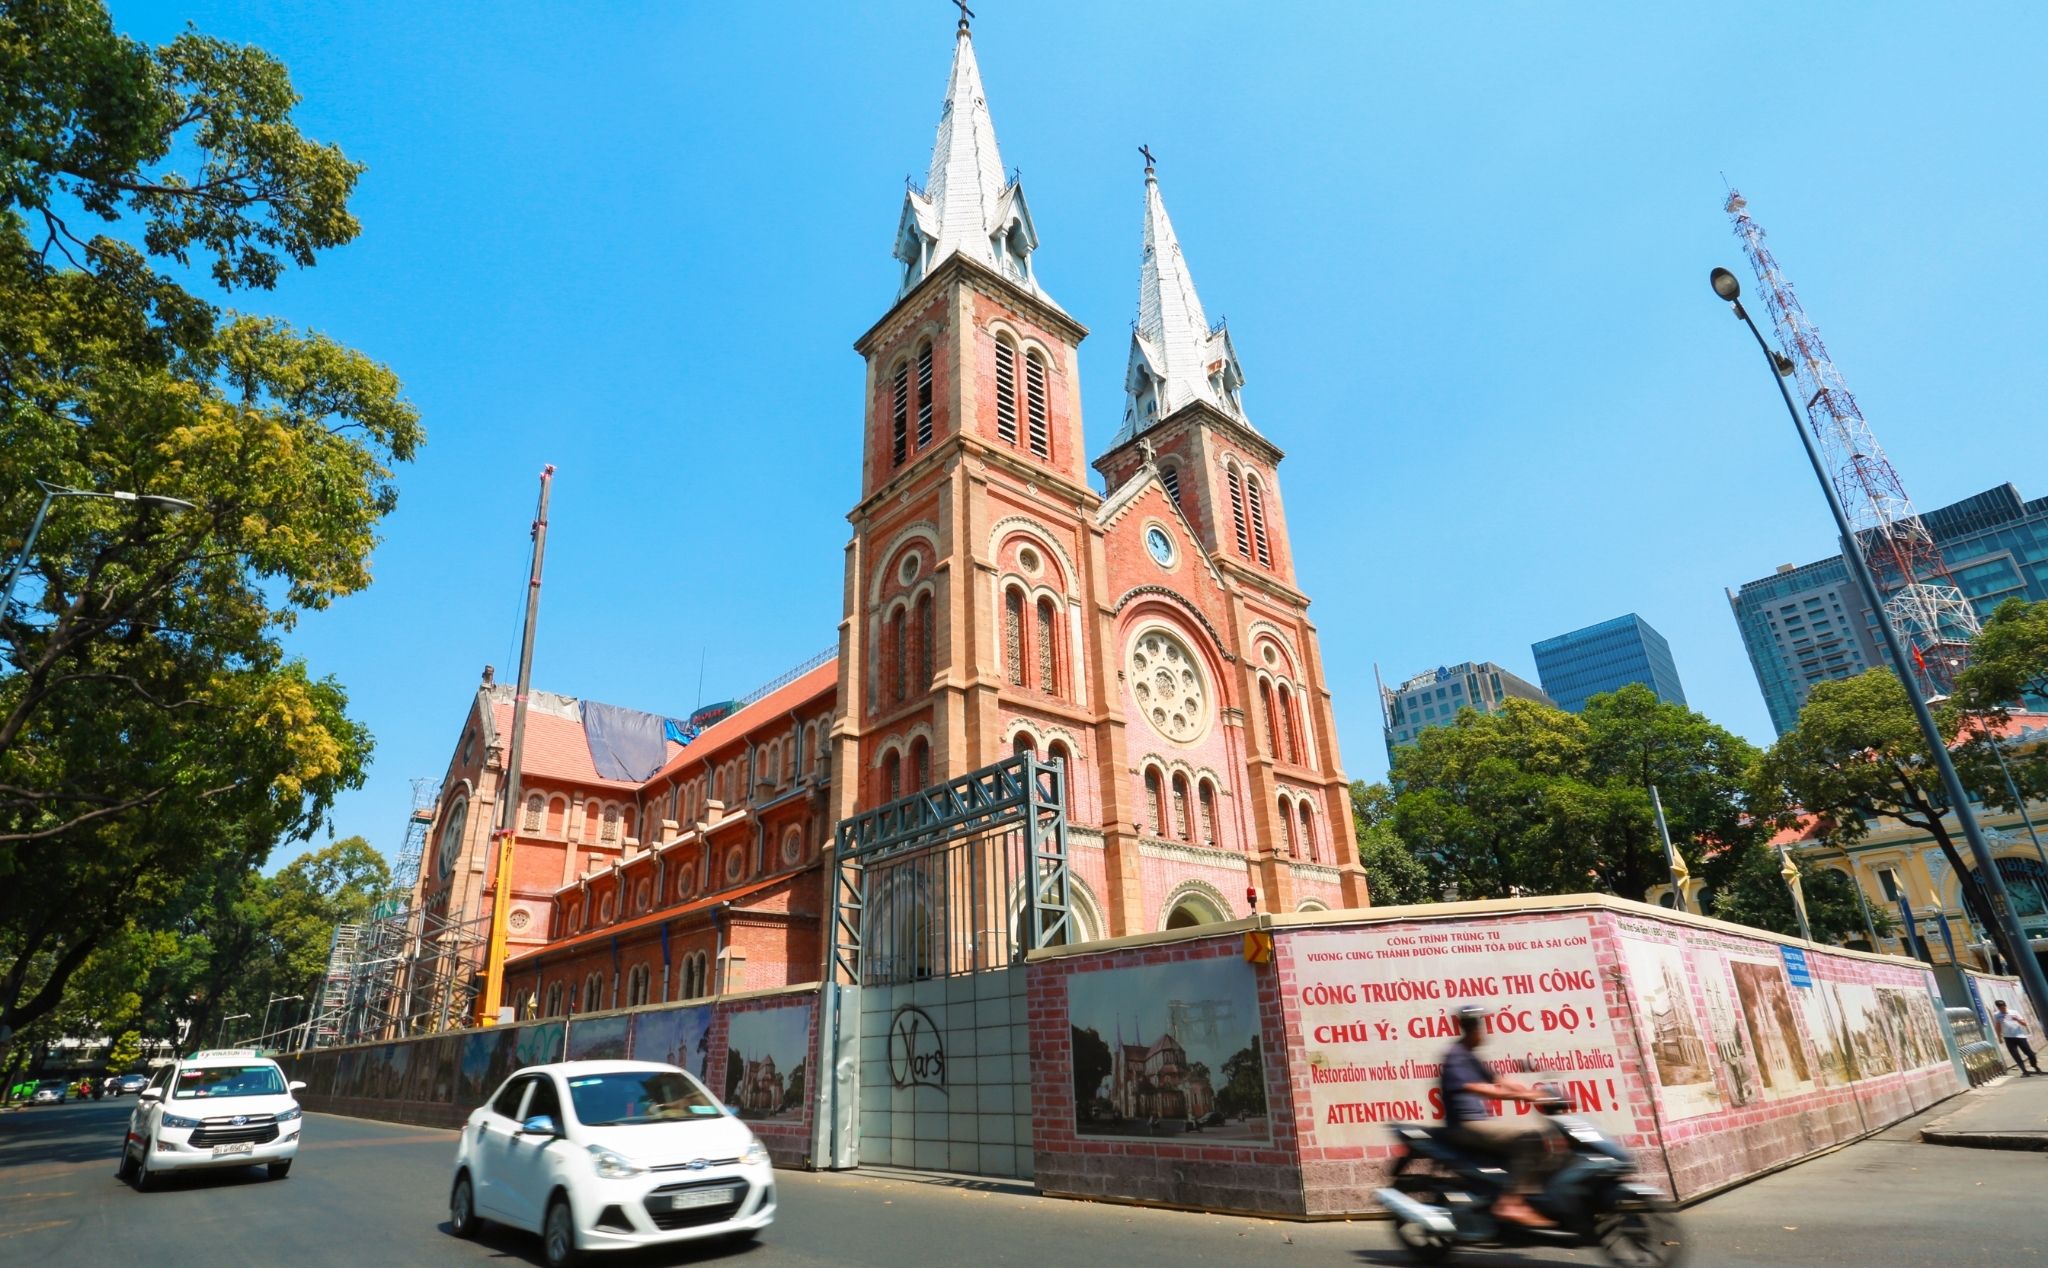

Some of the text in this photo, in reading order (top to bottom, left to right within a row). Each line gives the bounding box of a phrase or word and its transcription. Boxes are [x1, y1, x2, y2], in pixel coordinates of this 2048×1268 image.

[1346, 951, 1374, 960] CUNG
[1387, 936, 1416, 946] CÔNG
[1486, 931, 1500, 940] TU
[1302, 968, 1596, 1006] CÔNG TRƯỜNG ĐANG THI CÔNG
[1313, 1020, 1368, 1044] CHÚ
[1374, 1018, 1398, 1041] Ý:
[1481, 1004, 1535, 1035] TỐC
[1540, 1003, 1580, 1035] ĐỘ
[1586, 1006, 1596, 1029] !
[1311, 1062, 1367, 1084] Restoration
[1368, 1060, 1398, 1081] works
[1400, 1058, 1410, 1080] of
[1526, 1050, 1575, 1073] Cathedral
[1575, 1048, 1615, 1071] Basilica
[1327, 1100, 1425, 1125] ATTENTION:
[1605, 1078, 1619, 1111] !
